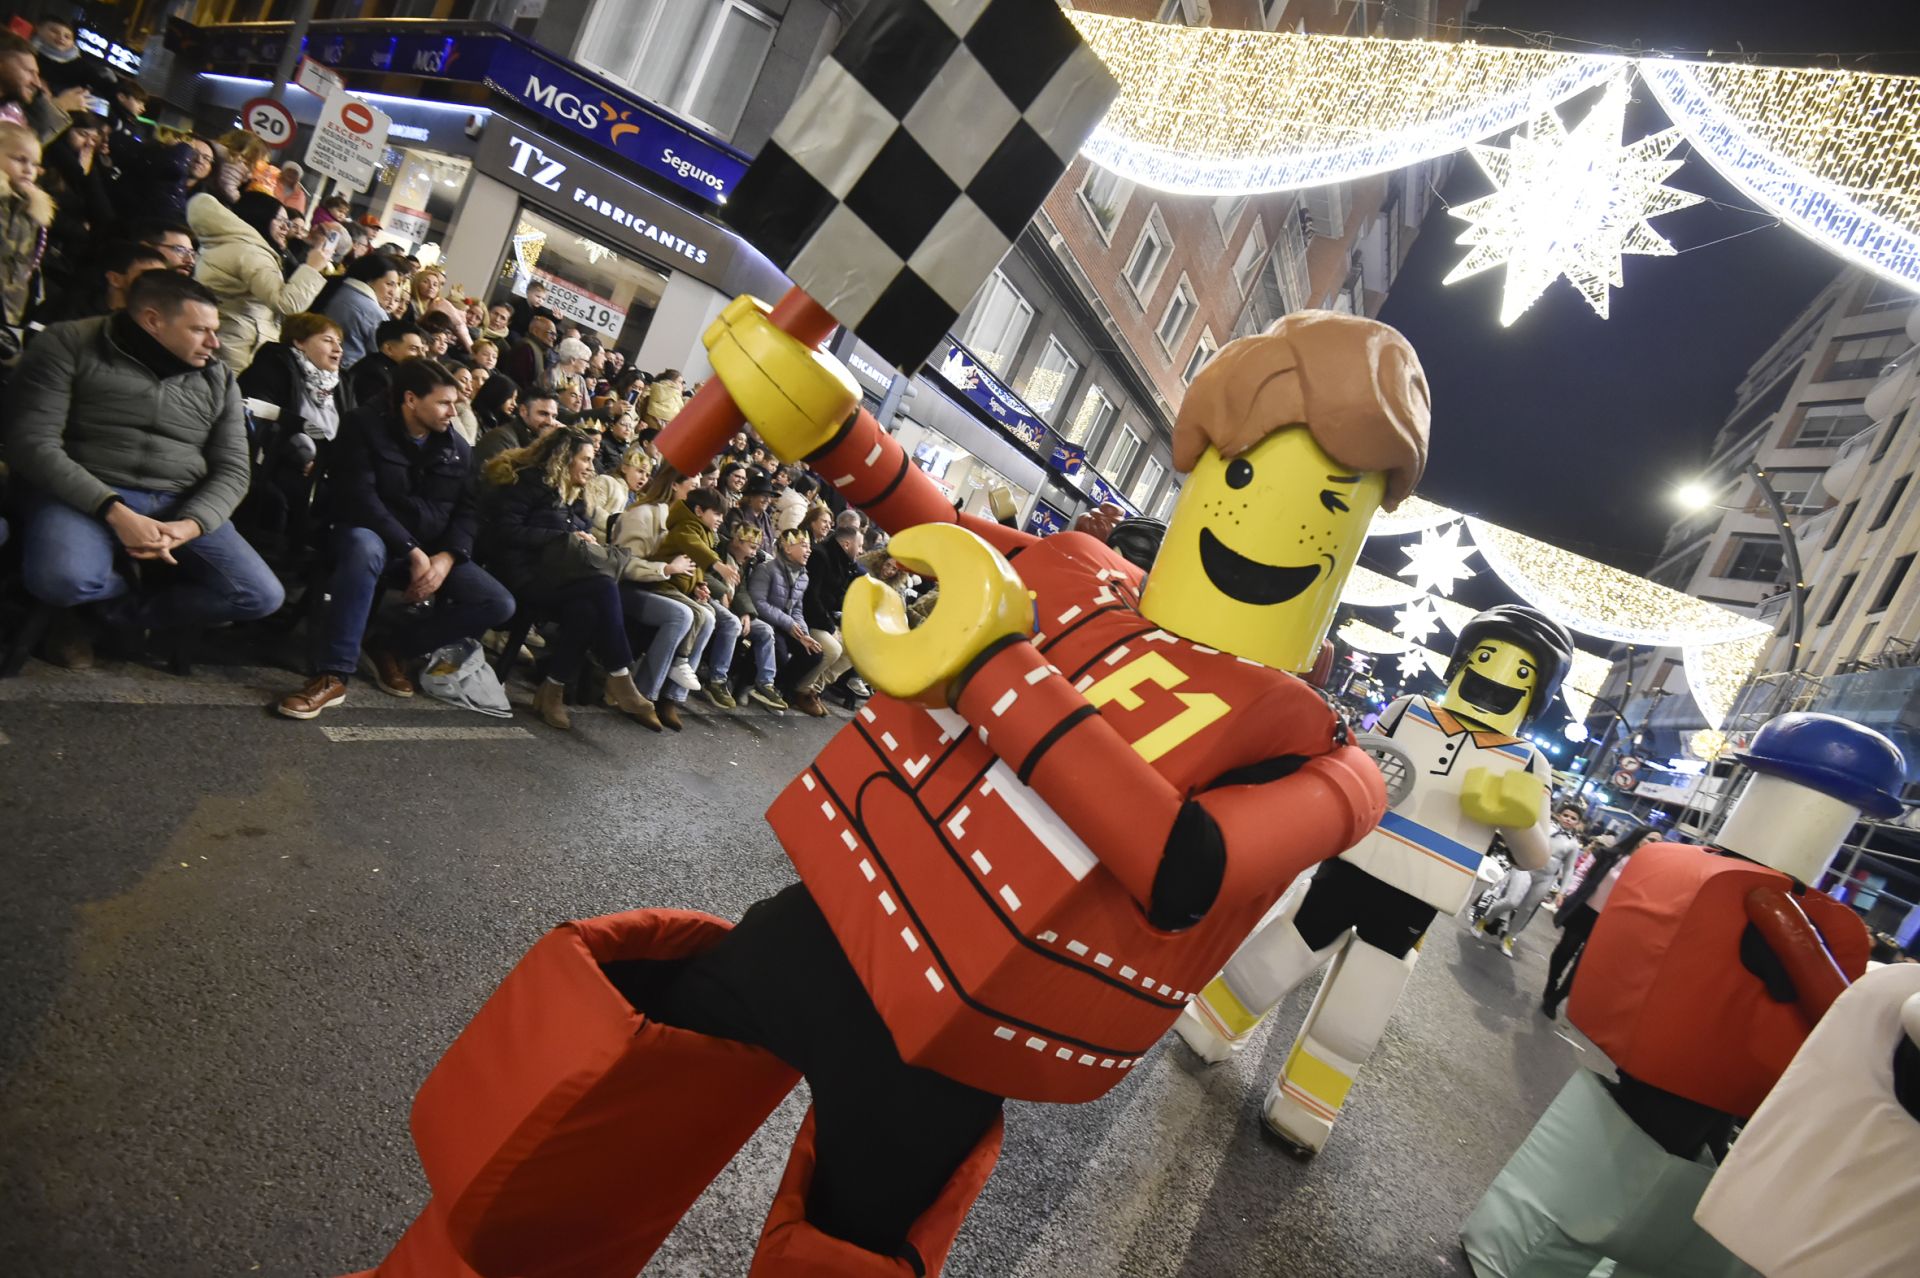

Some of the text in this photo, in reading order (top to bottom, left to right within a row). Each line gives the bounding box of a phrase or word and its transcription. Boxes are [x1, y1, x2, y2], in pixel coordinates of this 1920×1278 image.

[254, 111, 284, 136] 20
[524, 74, 725, 191] MGS Seguros
[321, 127, 359, 150] RESIDENTES
[327, 121, 373, 150] EXCEPTO
[311, 156, 330, 170] CARGA
[314, 150, 334, 165] HOTEL
[315, 142, 347, 162] GARAJES
[508, 135, 708, 264] TZ FABRICANTES
[546, 295, 585, 318] ERSEIS
[585, 305, 610, 327] 19
[1081, 650, 1233, 764] F1
